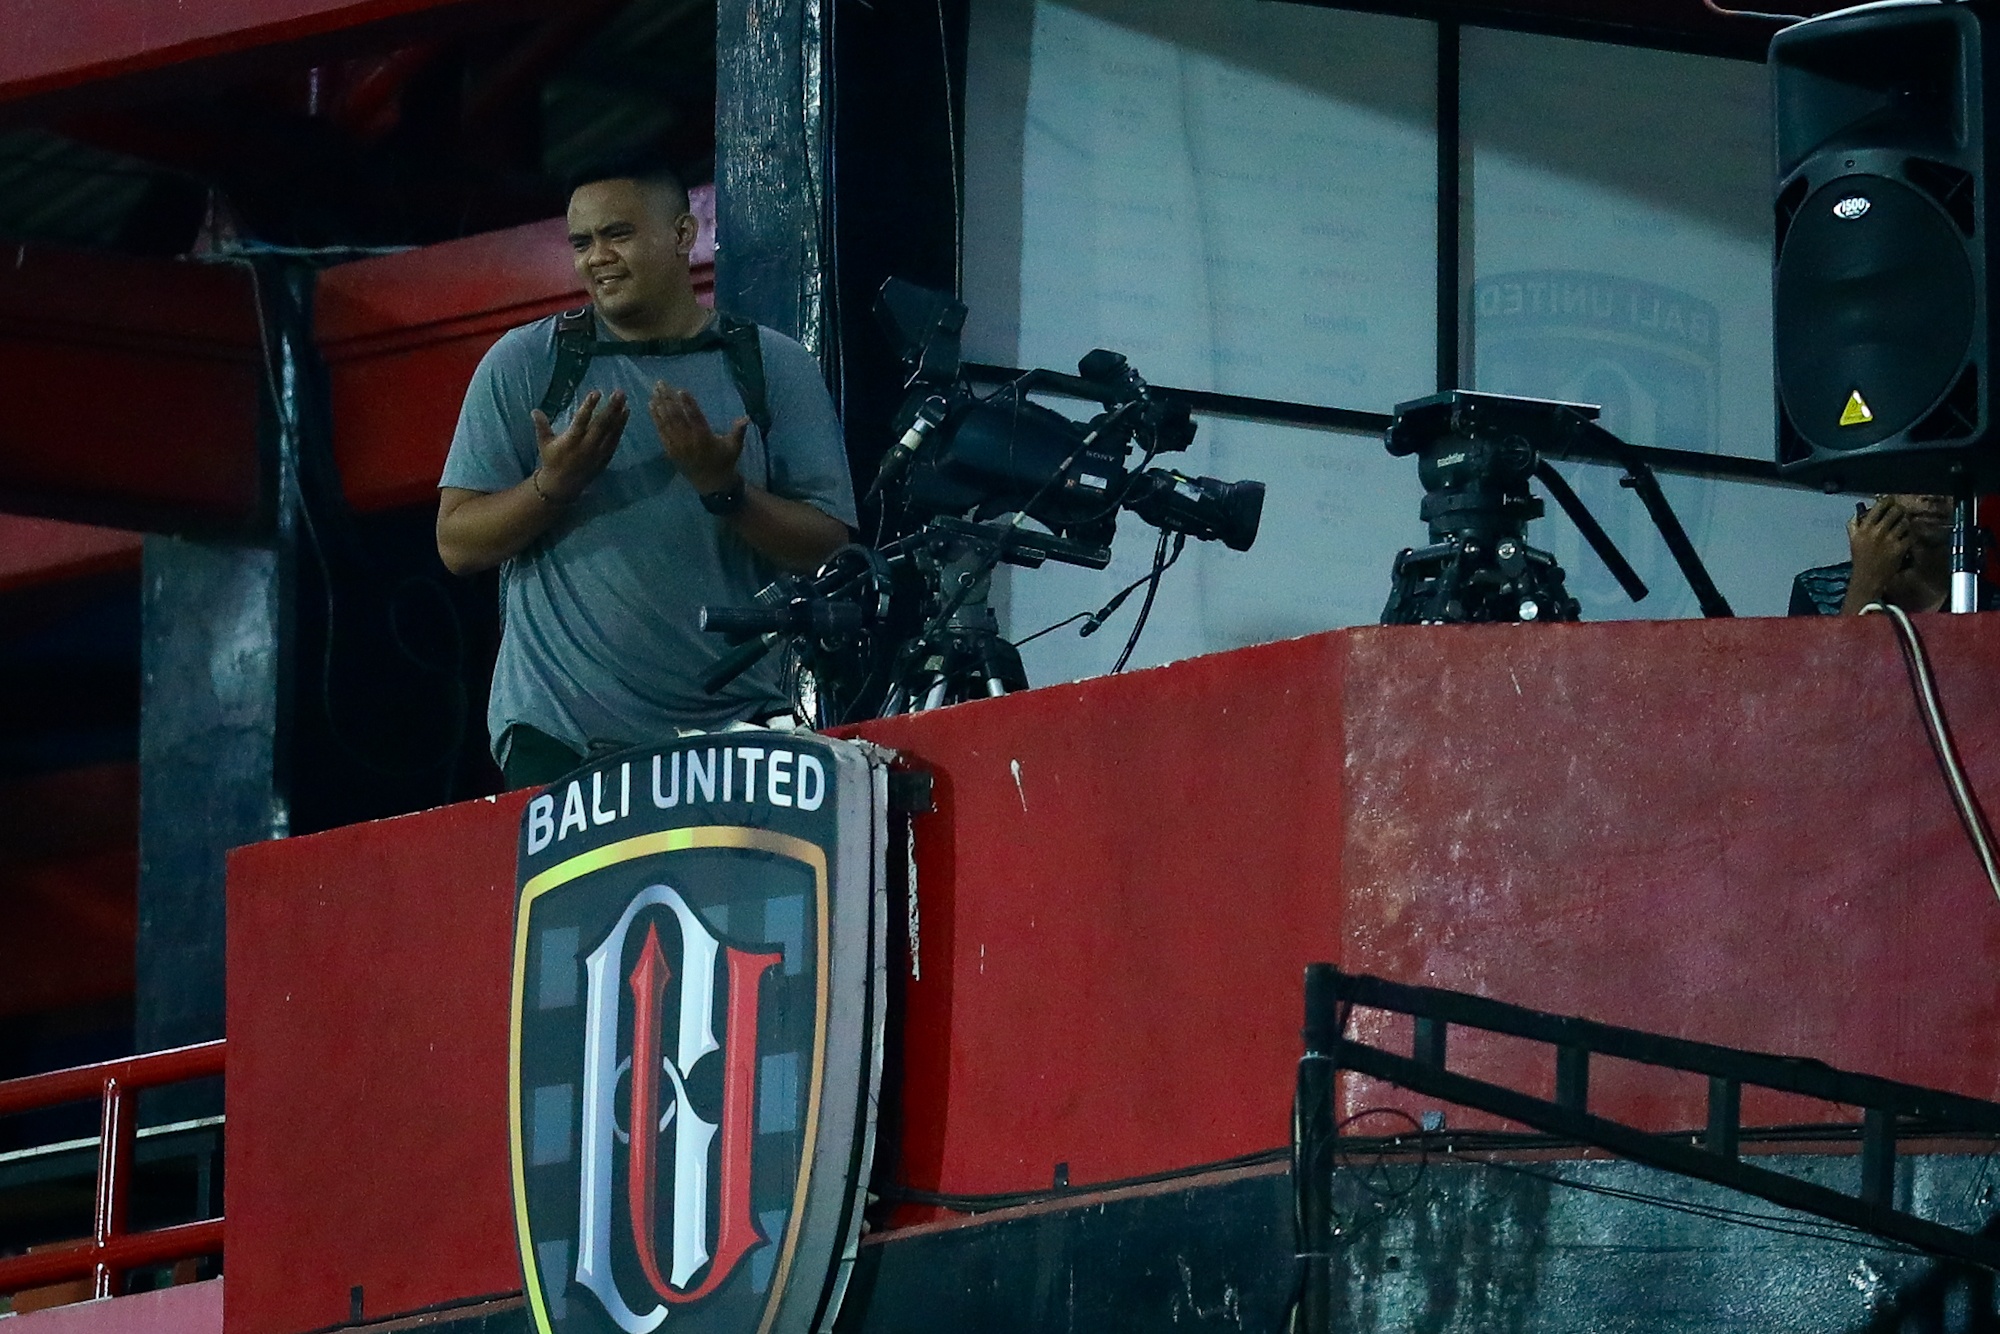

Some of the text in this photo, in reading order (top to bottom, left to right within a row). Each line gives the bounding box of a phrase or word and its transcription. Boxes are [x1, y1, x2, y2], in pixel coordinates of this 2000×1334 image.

[1842, 198, 1865, 213] 1500
[1086, 450, 1115, 462] SONY
[527, 747, 826, 856] BALI UNITED
